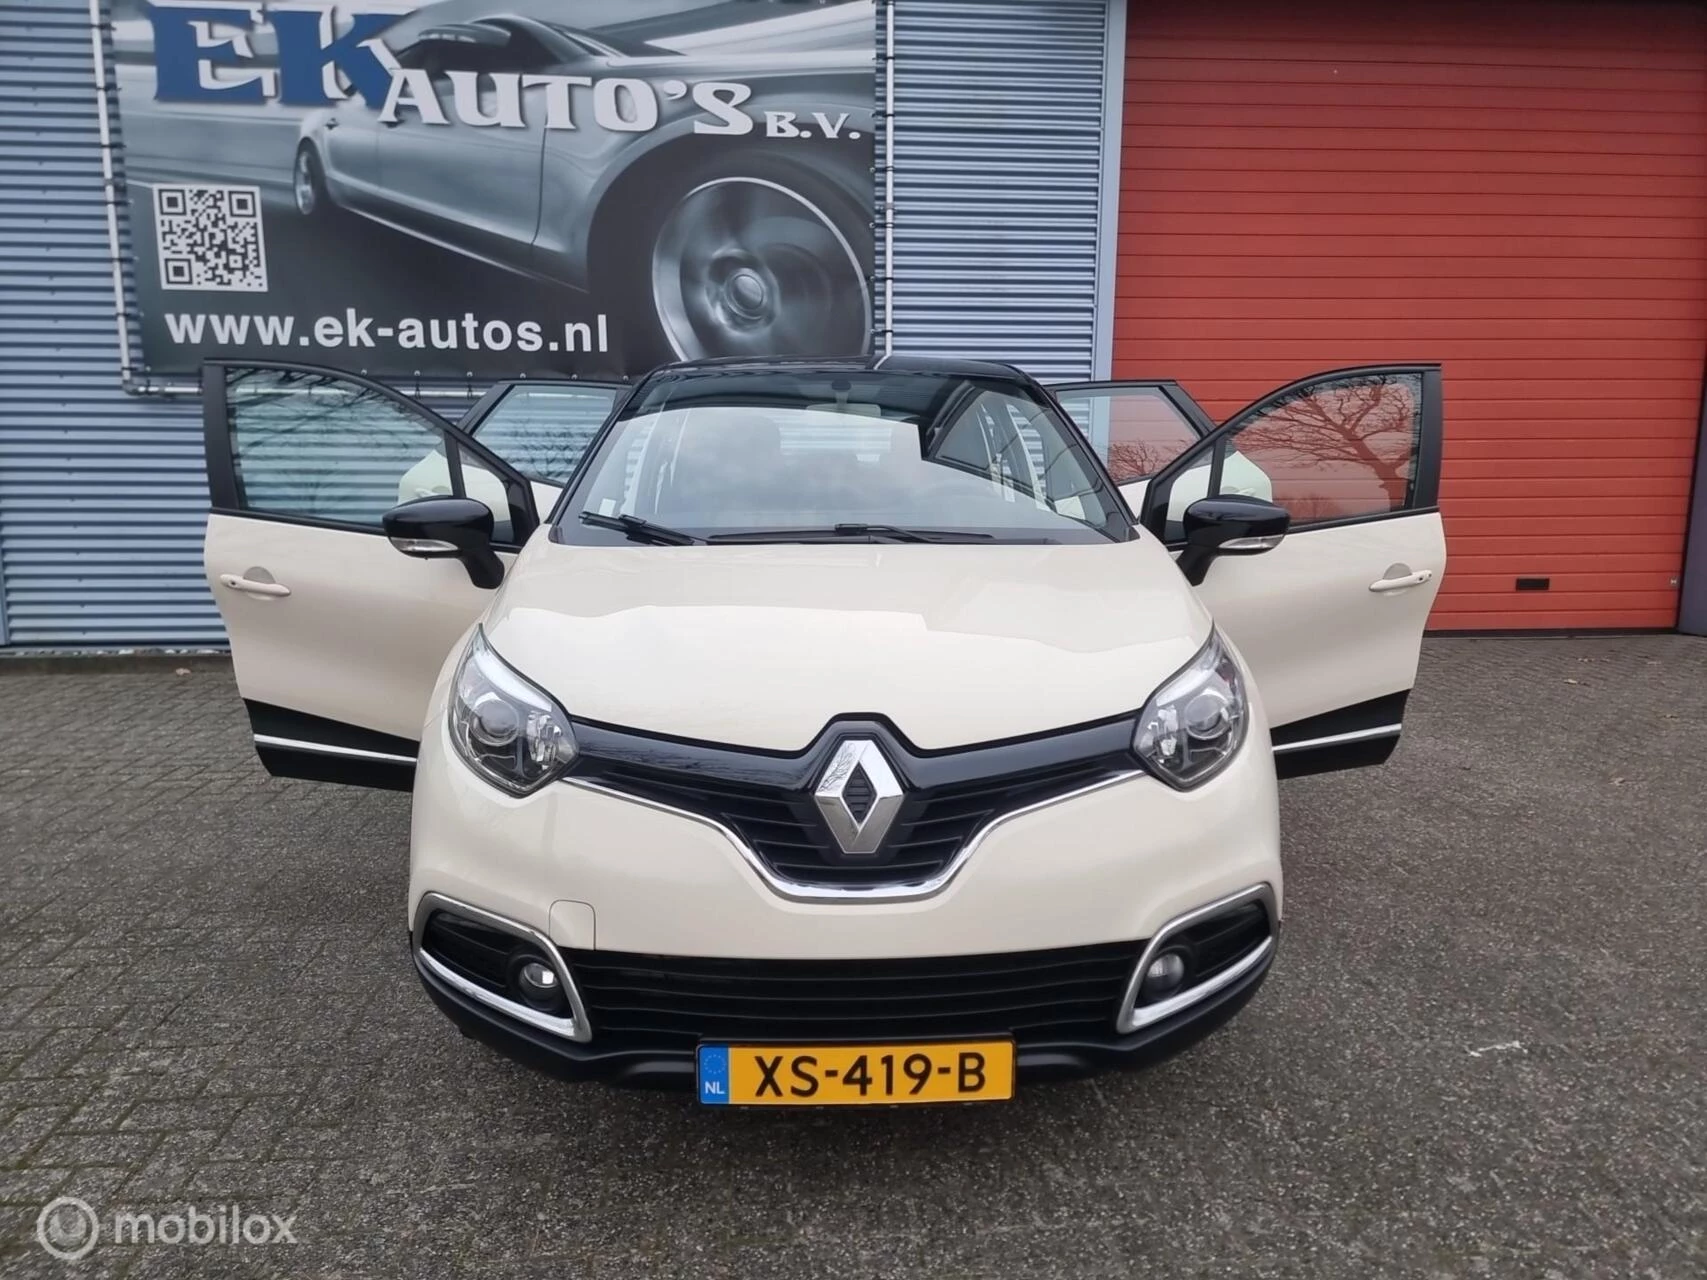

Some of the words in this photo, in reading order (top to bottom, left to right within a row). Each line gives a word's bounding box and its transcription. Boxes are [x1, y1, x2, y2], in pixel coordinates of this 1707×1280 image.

[149, 4, 416, 109] EK
[377, 71, 754, 136] AUTO'S
[765, 110, 861, 140] B.V.
[164, 308, 609, 353] www.ek-autos.nl
[704, 1081, 725, 1095] NL
[754, 1052, 986, 1097] XS-419-B
